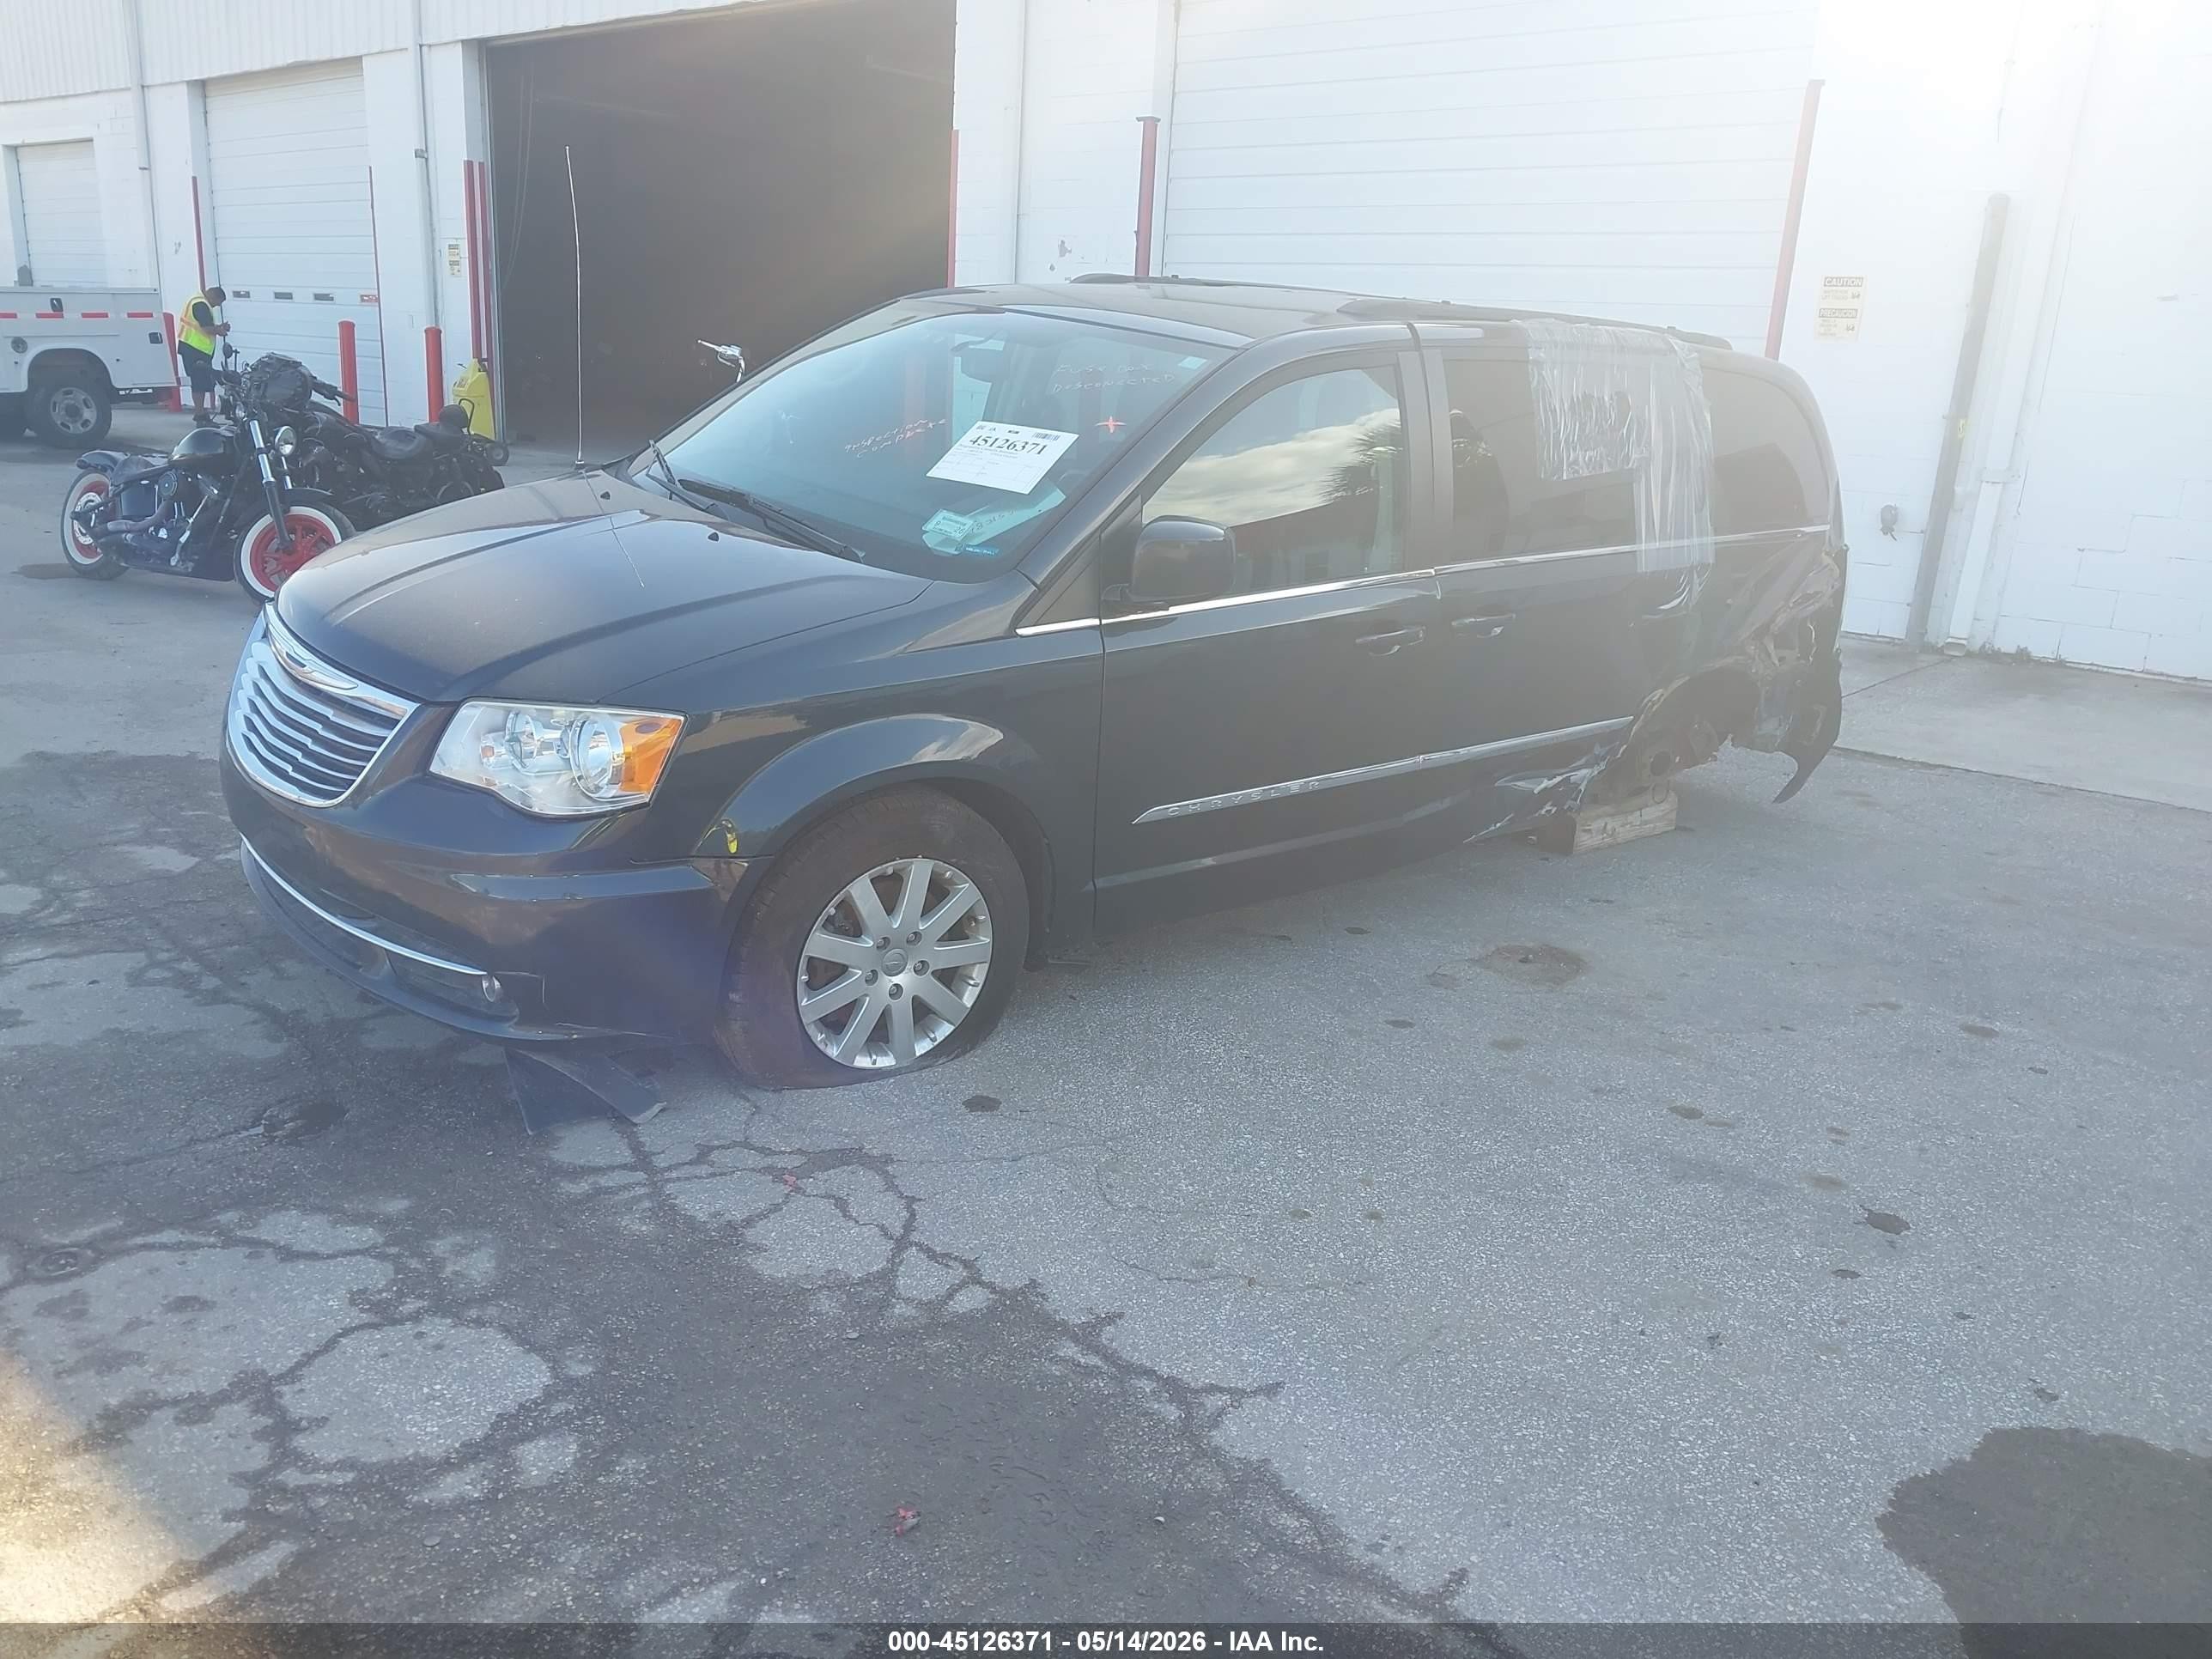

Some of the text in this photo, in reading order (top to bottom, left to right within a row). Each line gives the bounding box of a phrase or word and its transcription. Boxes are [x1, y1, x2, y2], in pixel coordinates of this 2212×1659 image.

[1826, 277, 1863, 286] CAUTION
[969, 434, 1048, 455] 45126371
[1168, 781, 1320, 816] CHRYSLER
